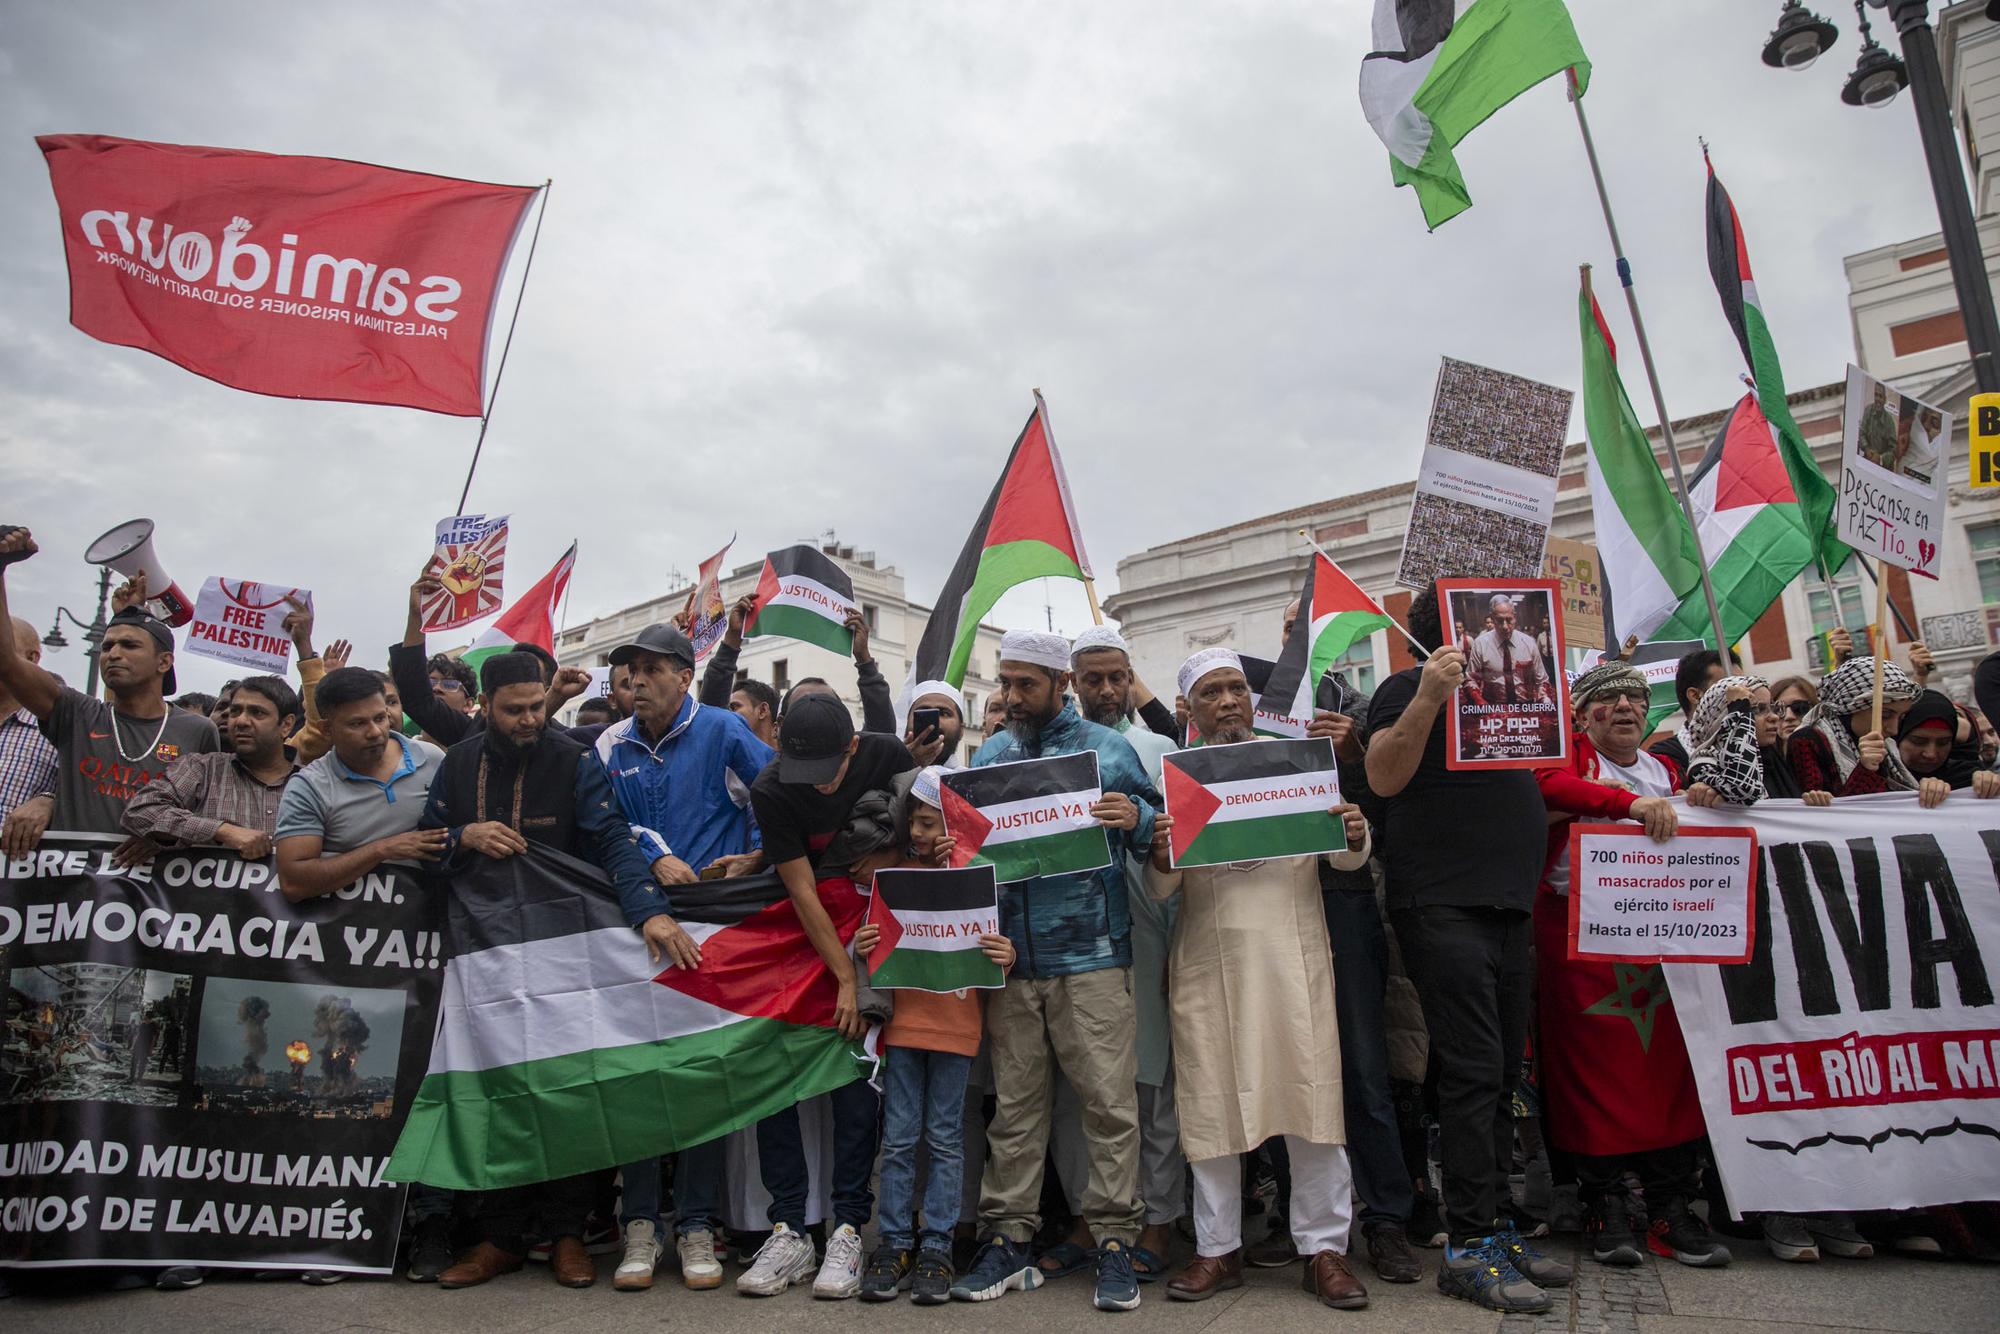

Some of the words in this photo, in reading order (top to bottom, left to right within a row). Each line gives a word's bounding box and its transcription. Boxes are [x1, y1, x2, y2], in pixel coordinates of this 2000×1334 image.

[1435, 471, 1447, 479] 700
[1447, 474, 1463, 483] niños
[1493, 487, 1528, 500] masacrados
[1439, 481, 1462, 492] ejército
[1480, 492, 1497, 501] hasta
[1504, 498, 1538, 513] 15/10/2023
[1844, 468, 1910, 525] Descansa
[1915, 508, 1929, 531] en
[781, 585, 828, 607] JUSTICIA
[831, 600, 844, 615] YA
[222, 605, 267, 630] FREE
[191, 620, 291, 657] PALESTINE
[1461, 704, 1506, 714] CRIMINAL
[1508, 704, 1520, 713] DE
[1522, 703, 1557, 713] GUERRA
[1226, 787, 1307, 806] DEMOCRACIA
[1309, 784, 1326, 796] YA
[1329, 783, 1338, 793] !!
[996, 808, 1059, 830] JUSTICIA
[1062, 804, 1083, 818] YA
[96, 852, 156, 883] DE
[1590, 850, 1618, 864] 700
[1622, 851, 1663, 865] niños
[1667, 852, 1740, 868] palestinos
[1598, 875, 1685, 889] masacrados
[1689, 880, 1714, 890] por
[1718, 876, 1731, 889] el
[1614, 898, 1669, 914] ejército
[1673, 898, 1716, 912] israelí
[0, 900, 325, 963] DEMOCRACIA
[343, 926, 441, 970] YA!!
[905, 923, 956, 937] JUSTICIA
[960, 922, 982, 936] YA
[987, 919, 997, 933] !!
[1589, 923, 1631, 937] Hasta
[1636, 924, 1649, 937] el
[1653, 922, 1737, 939] 15/10/2023
[1719, 833, 1994, 1025] VIVA
[1733, 1053, 1815, 1103] DEL
[1820, 1037, 1882, 1098] RÍO
[1888, 1042, 1938, 1093] AL
[137, 1144, 397, 1188] MUSULMANA
[0, 1195, 91, 1232] CINOS
[100, 1196, 157, 1232] DE
[165, 1198, 373, 1241] LAVAPIÉS.
